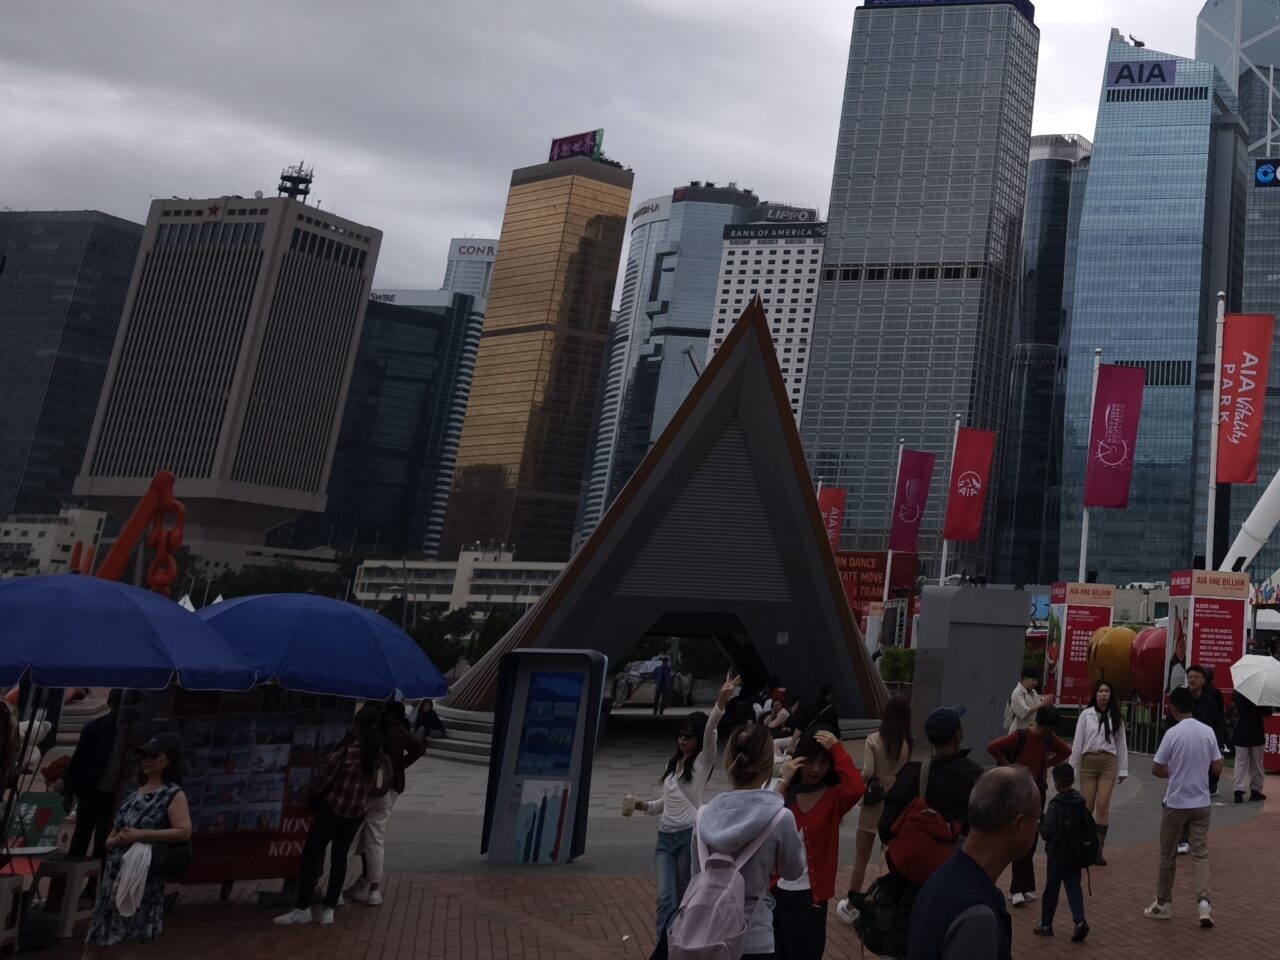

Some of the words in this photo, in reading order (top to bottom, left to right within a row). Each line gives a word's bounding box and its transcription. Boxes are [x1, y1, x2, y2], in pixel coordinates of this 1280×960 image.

[1114, 63, 1167, 84] AIA
[767, 209, 809, 222] LIPPO
[730, 229, 756, 238] BANK
[757, 229, 769, 237] OF
[770, 228, 812, 237] AMERICA
[370, 291, 396, 302] SWIRE
[1237, 351, 1259, 393] AIA
[1219, 363, 1236, 423] PARK
[1226, 397, 1255, 445] Vitality
[957, 488, 978, 497] AIA
[827, 506, 839, 527] AIA
[848, 557, 878, 569] DANCE
[860, 572, 884, 583] MOVE
[1196, 576, 1208, 585] AIA
